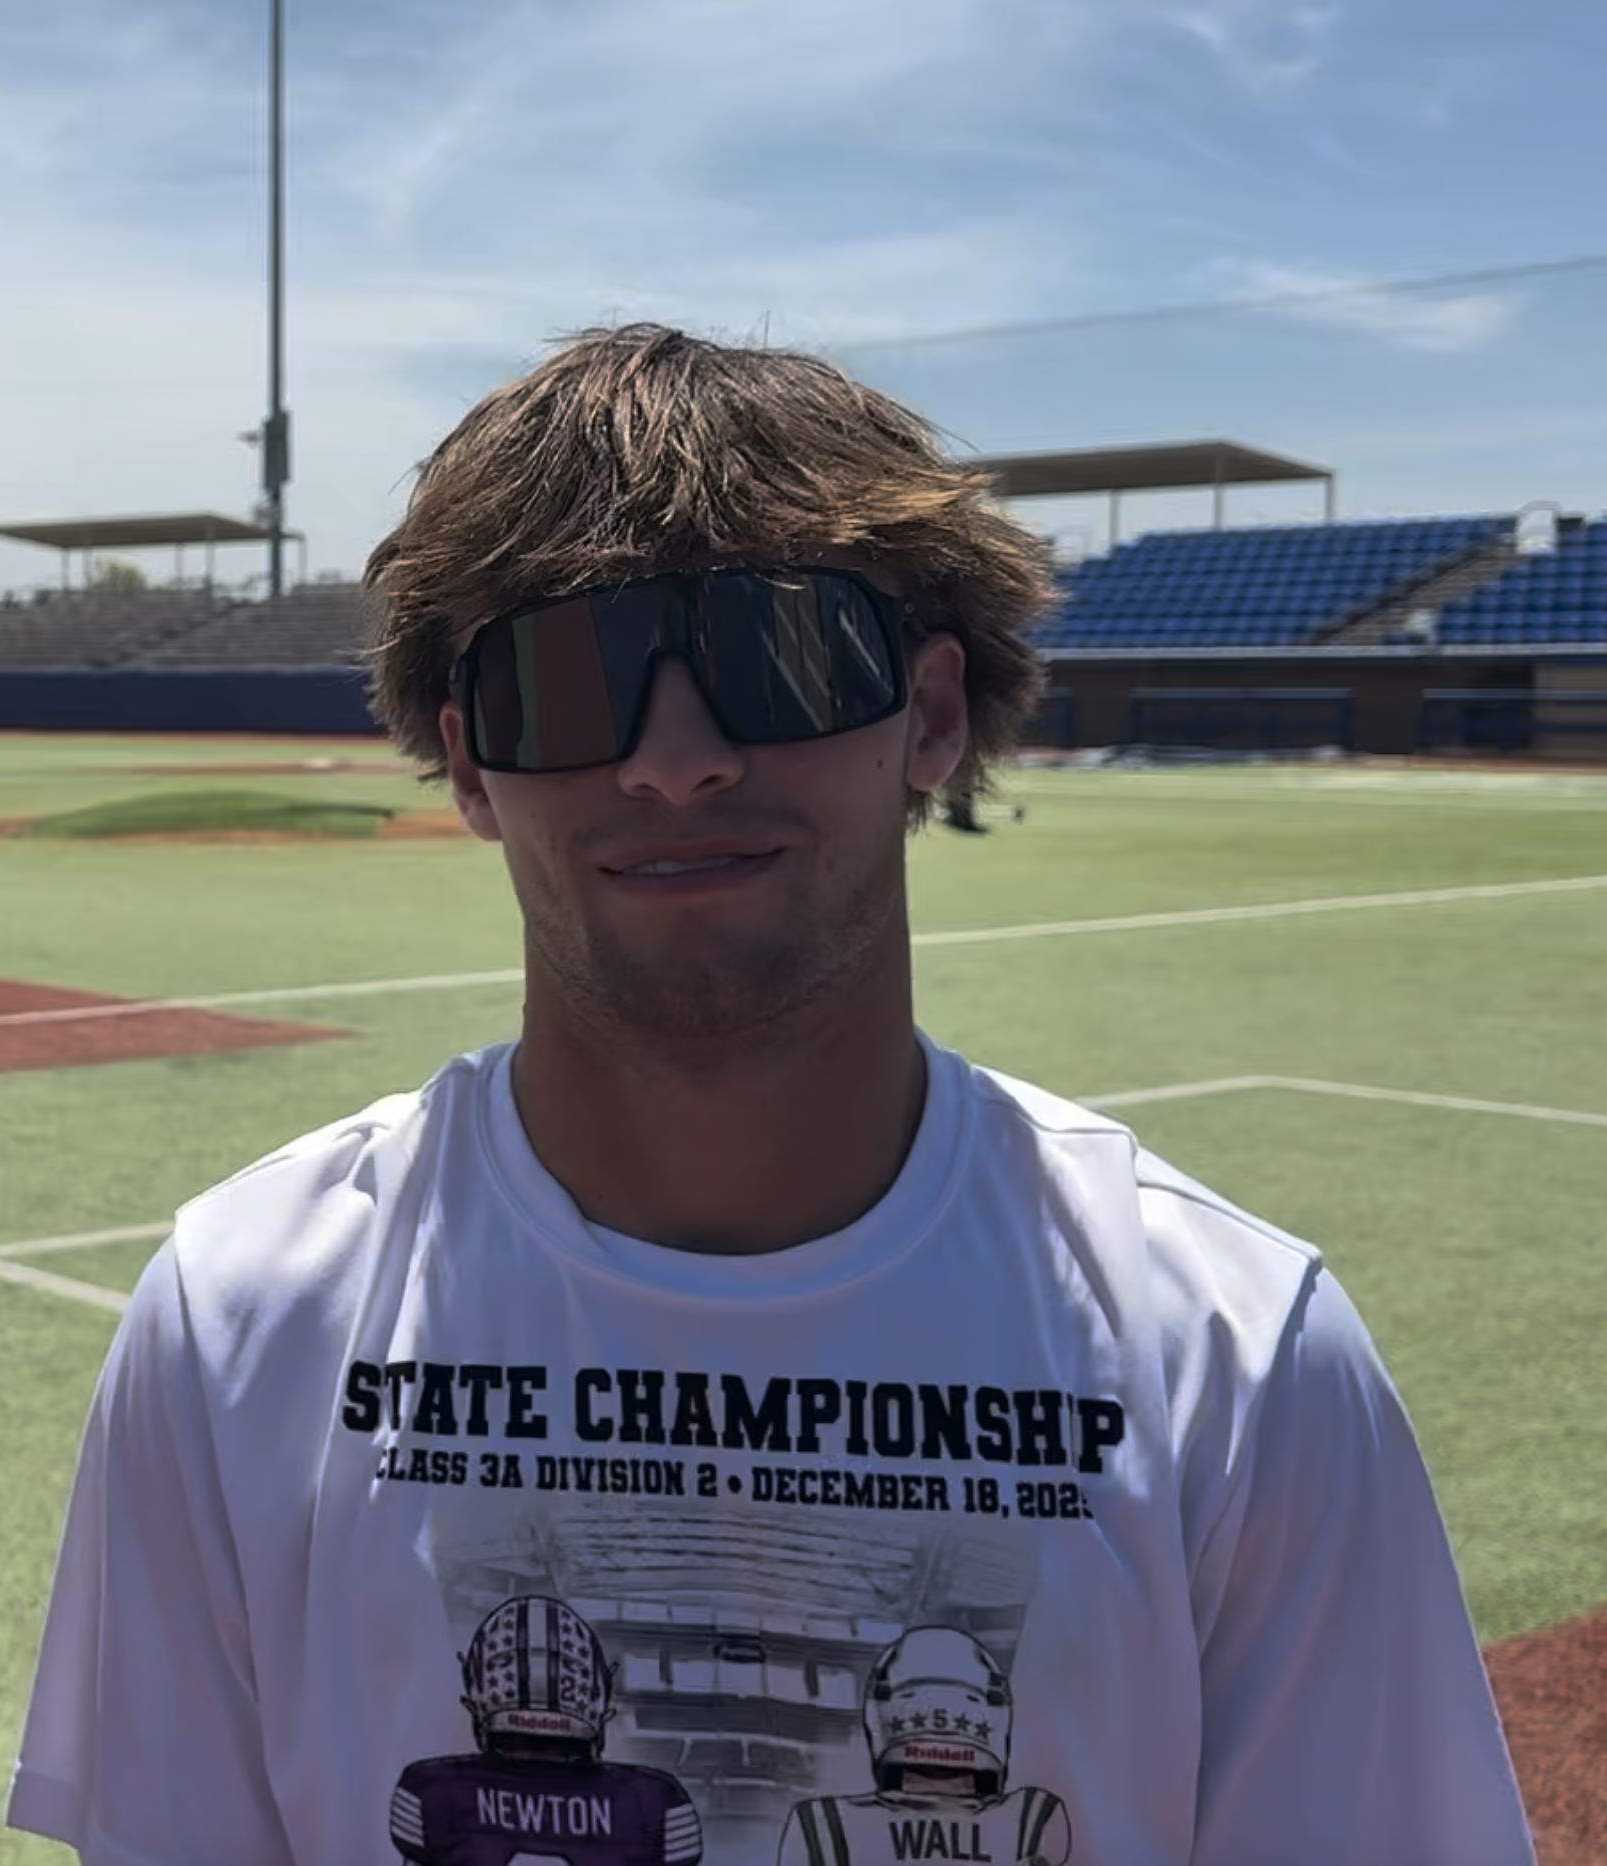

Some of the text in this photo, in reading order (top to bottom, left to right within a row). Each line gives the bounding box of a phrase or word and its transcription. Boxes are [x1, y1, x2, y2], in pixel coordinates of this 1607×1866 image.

[342, 1360, 1124, 1473] STATE CHAMPIONSHP
[480, 1453, 523, 1488] 3A
[536, 1455, 684, 1496] DIVISION
[697, 1463, 718, 1497] 2
[751, 1466, 950, 1513] DECEMBER
[963, 1477, 1009, 1519] 18,
[933, 1709, 947, 1728] 5
[904, 1746, 975, 1761] Riddell
[477, 1788, 611, 1836] NEWTON
[890, 1820, 992, 1862] WALL
